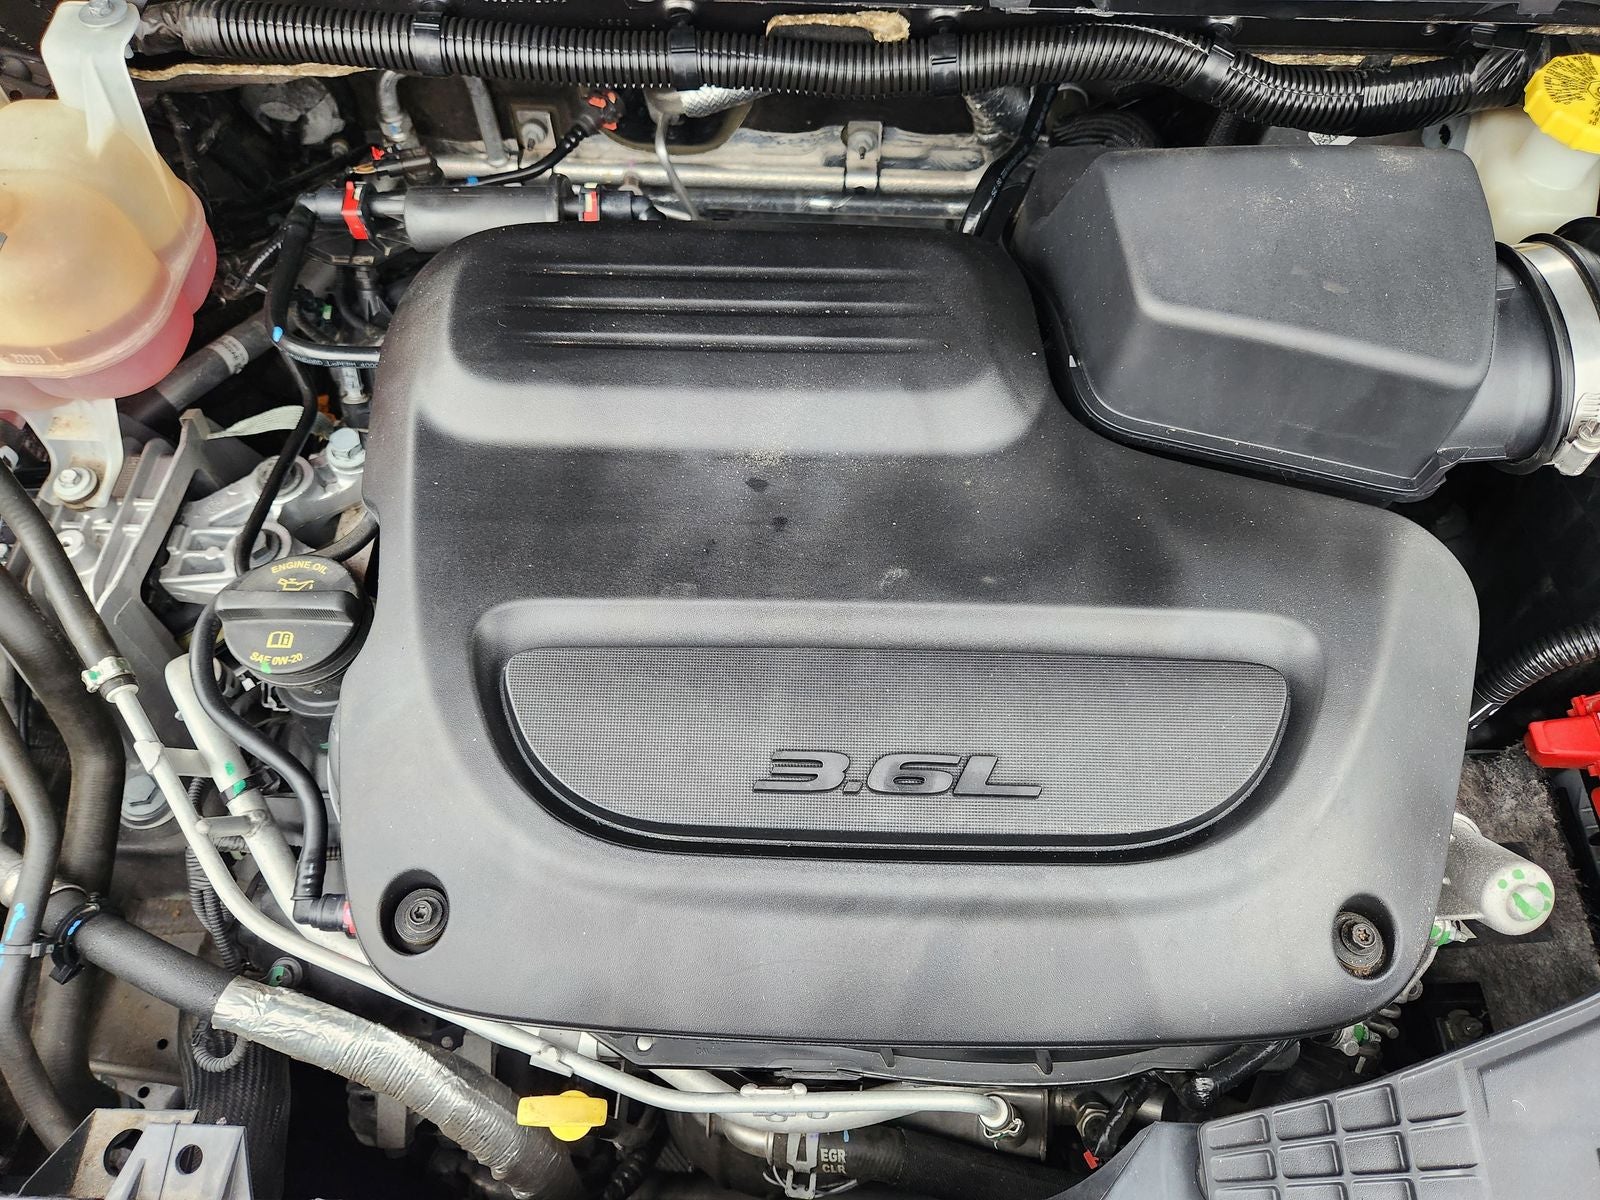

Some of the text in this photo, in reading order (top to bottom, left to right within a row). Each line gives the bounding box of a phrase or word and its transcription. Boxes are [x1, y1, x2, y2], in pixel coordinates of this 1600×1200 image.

[271, 561, 328, 575] ENGINE OIL
[250, 652, 303, 665] SAE 0W-20
[753, 750, 1043, 799] 3.6L
[820, 1148, 847, 1163] EGR
[822, 1164, 847, 1175] CLR
